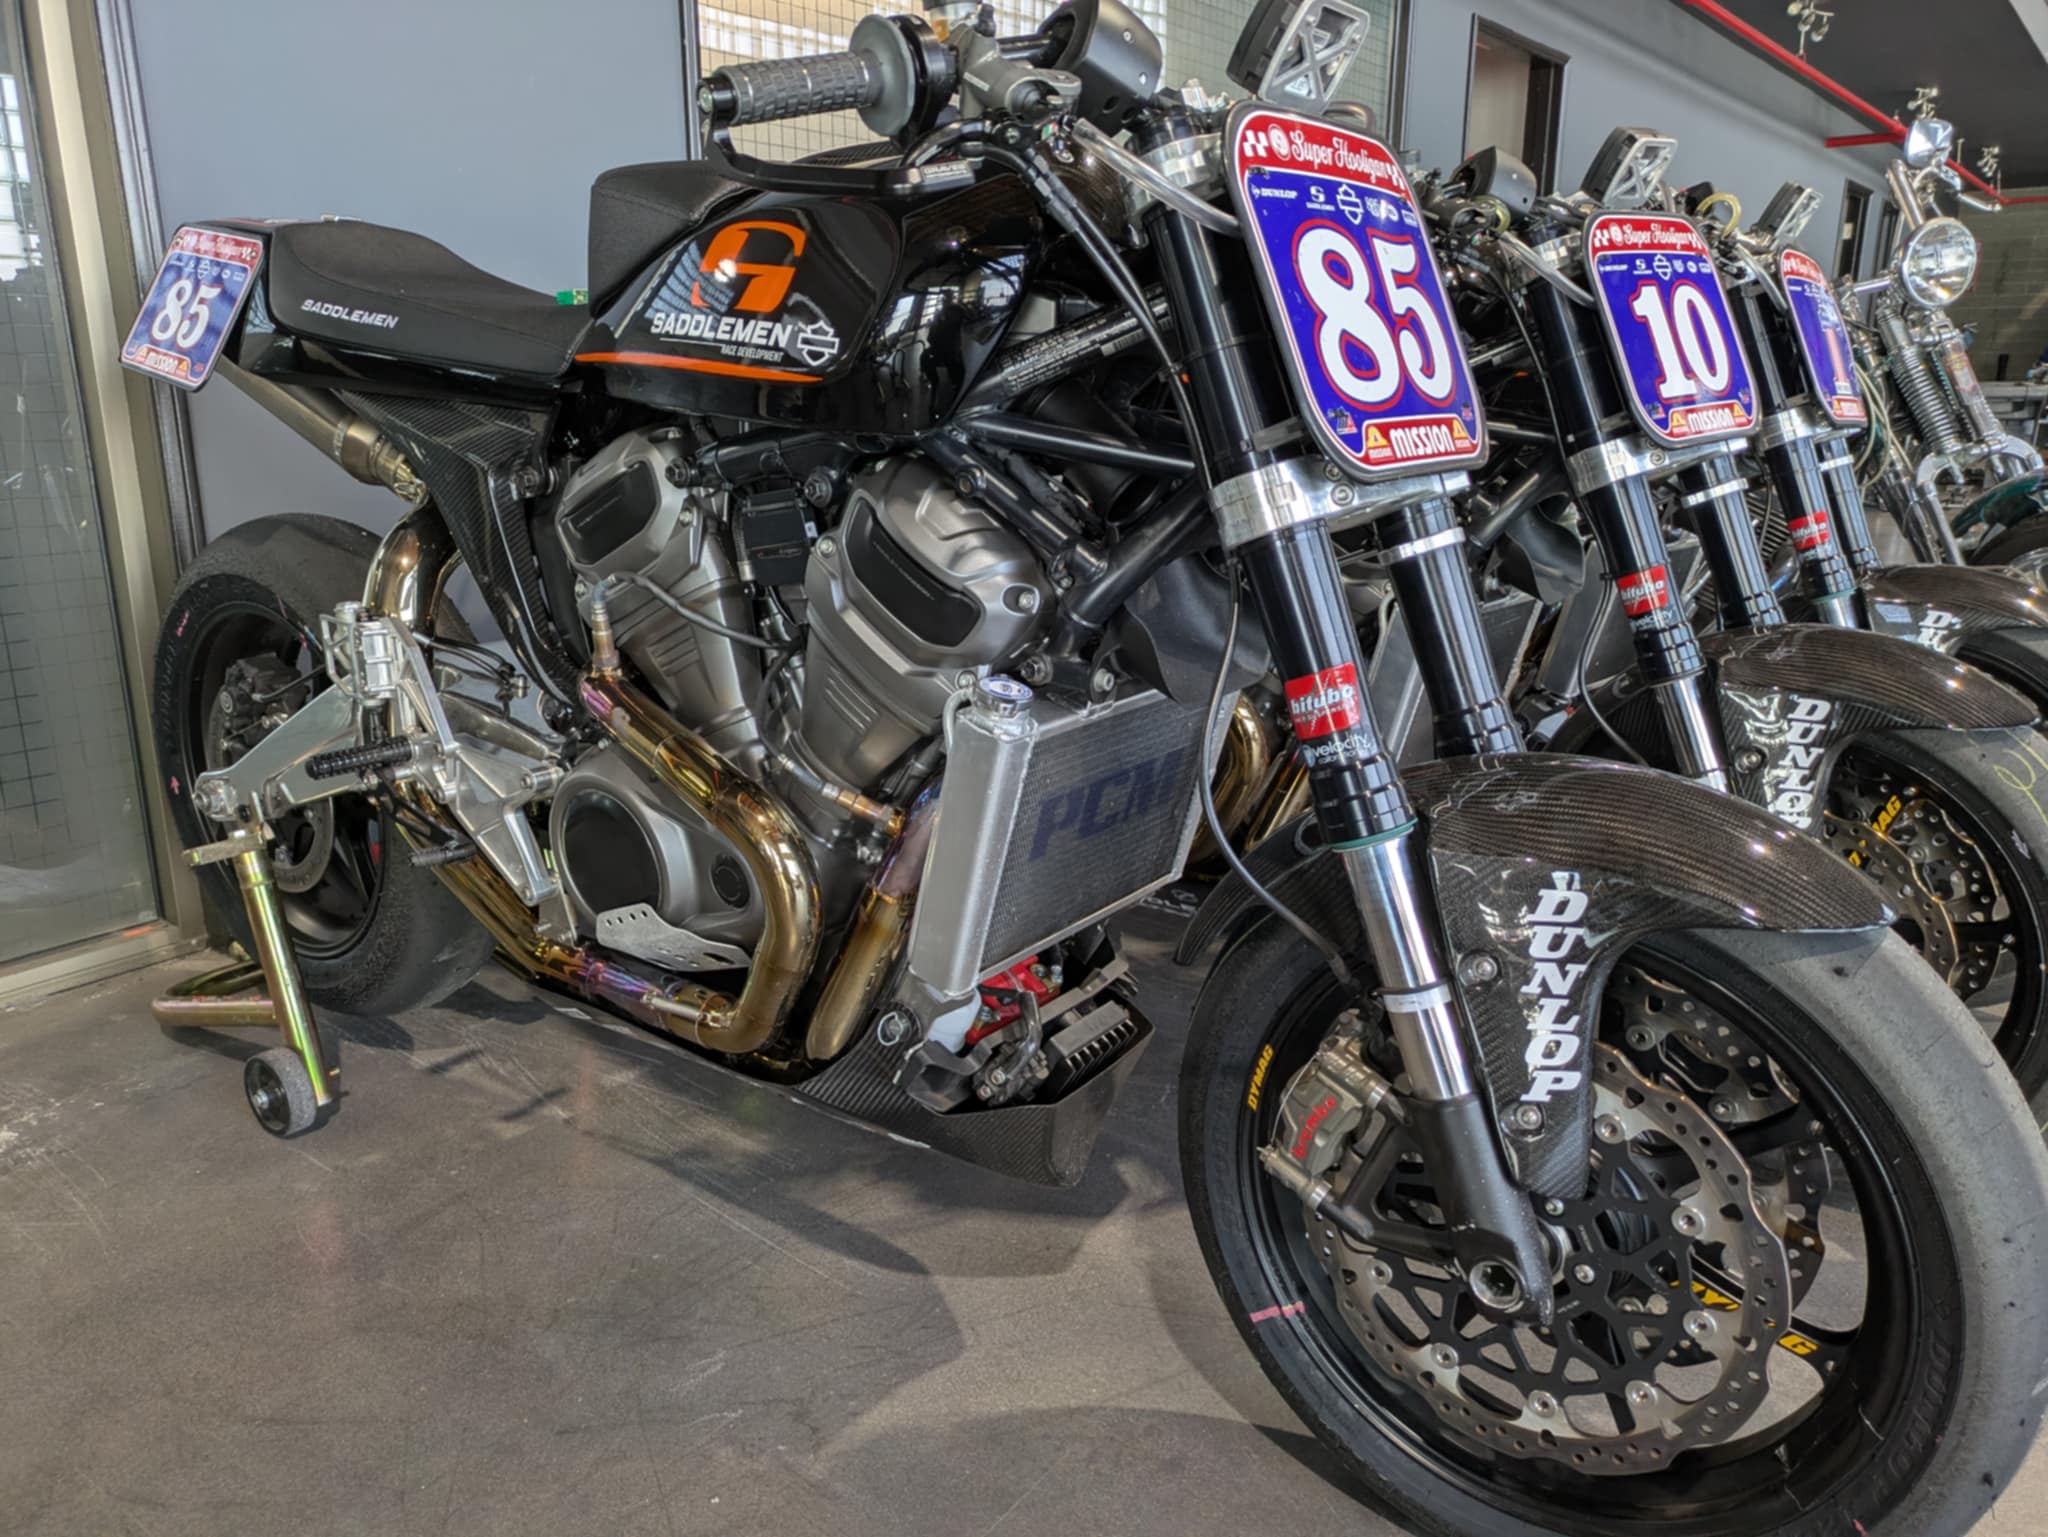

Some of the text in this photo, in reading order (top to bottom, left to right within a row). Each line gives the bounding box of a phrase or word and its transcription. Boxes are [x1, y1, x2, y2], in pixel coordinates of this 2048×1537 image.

[1290, 130, 1389, 183] Super Hooligan
[151, 278, 223, 348] 85
[301, 299, 400, 329] SADDLEMEN
[650, 311, 793, 348] SADDLEMEN
[1296, 226, 1454, 404] 85
[720, 344, 784, 363] RACE DEVELOPMENT
[1632, 284, 1730, 400] 10
[1389, 424, 1457, 459] MISSION
[1688, 408, 1735, 433] MISSION
[1290, 684, 1355, 715] bitubo
[1313, 732, 1372, 757] velocity
[1028, 747, 1186, 862] PCM
[1519, 888, 1589, 1102] DUNLOP
[1247, 1043, 1275, 1112] DYMAG
[1290, 1095, 1338, 1160] brembo
